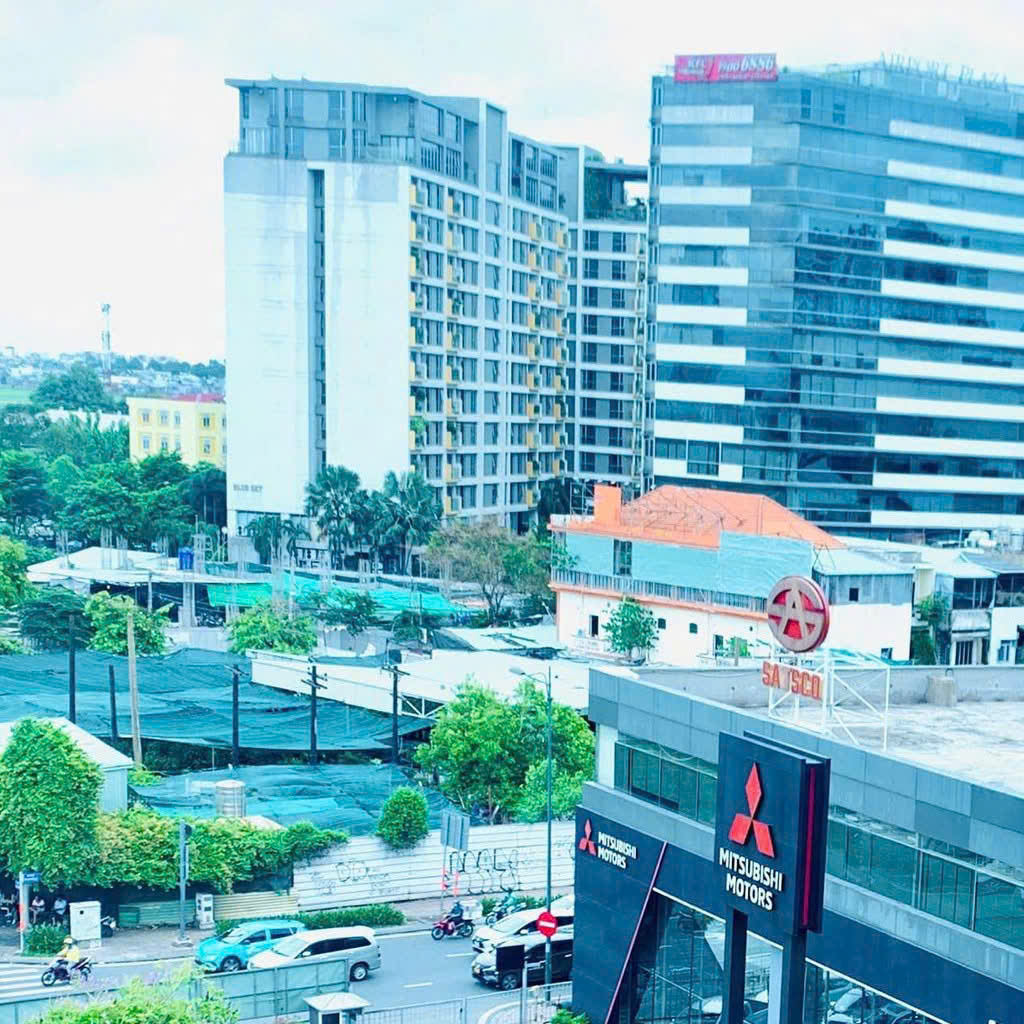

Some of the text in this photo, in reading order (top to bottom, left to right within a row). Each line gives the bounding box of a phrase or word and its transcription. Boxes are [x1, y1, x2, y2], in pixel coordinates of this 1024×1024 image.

[598, 831, 637, 859] MITSUBISHI
[598, 846, 627, 869] MOTORS
[719, 847, 783, 892] MITSUBISHI
[726, 873, 774, 910] MOTORS
